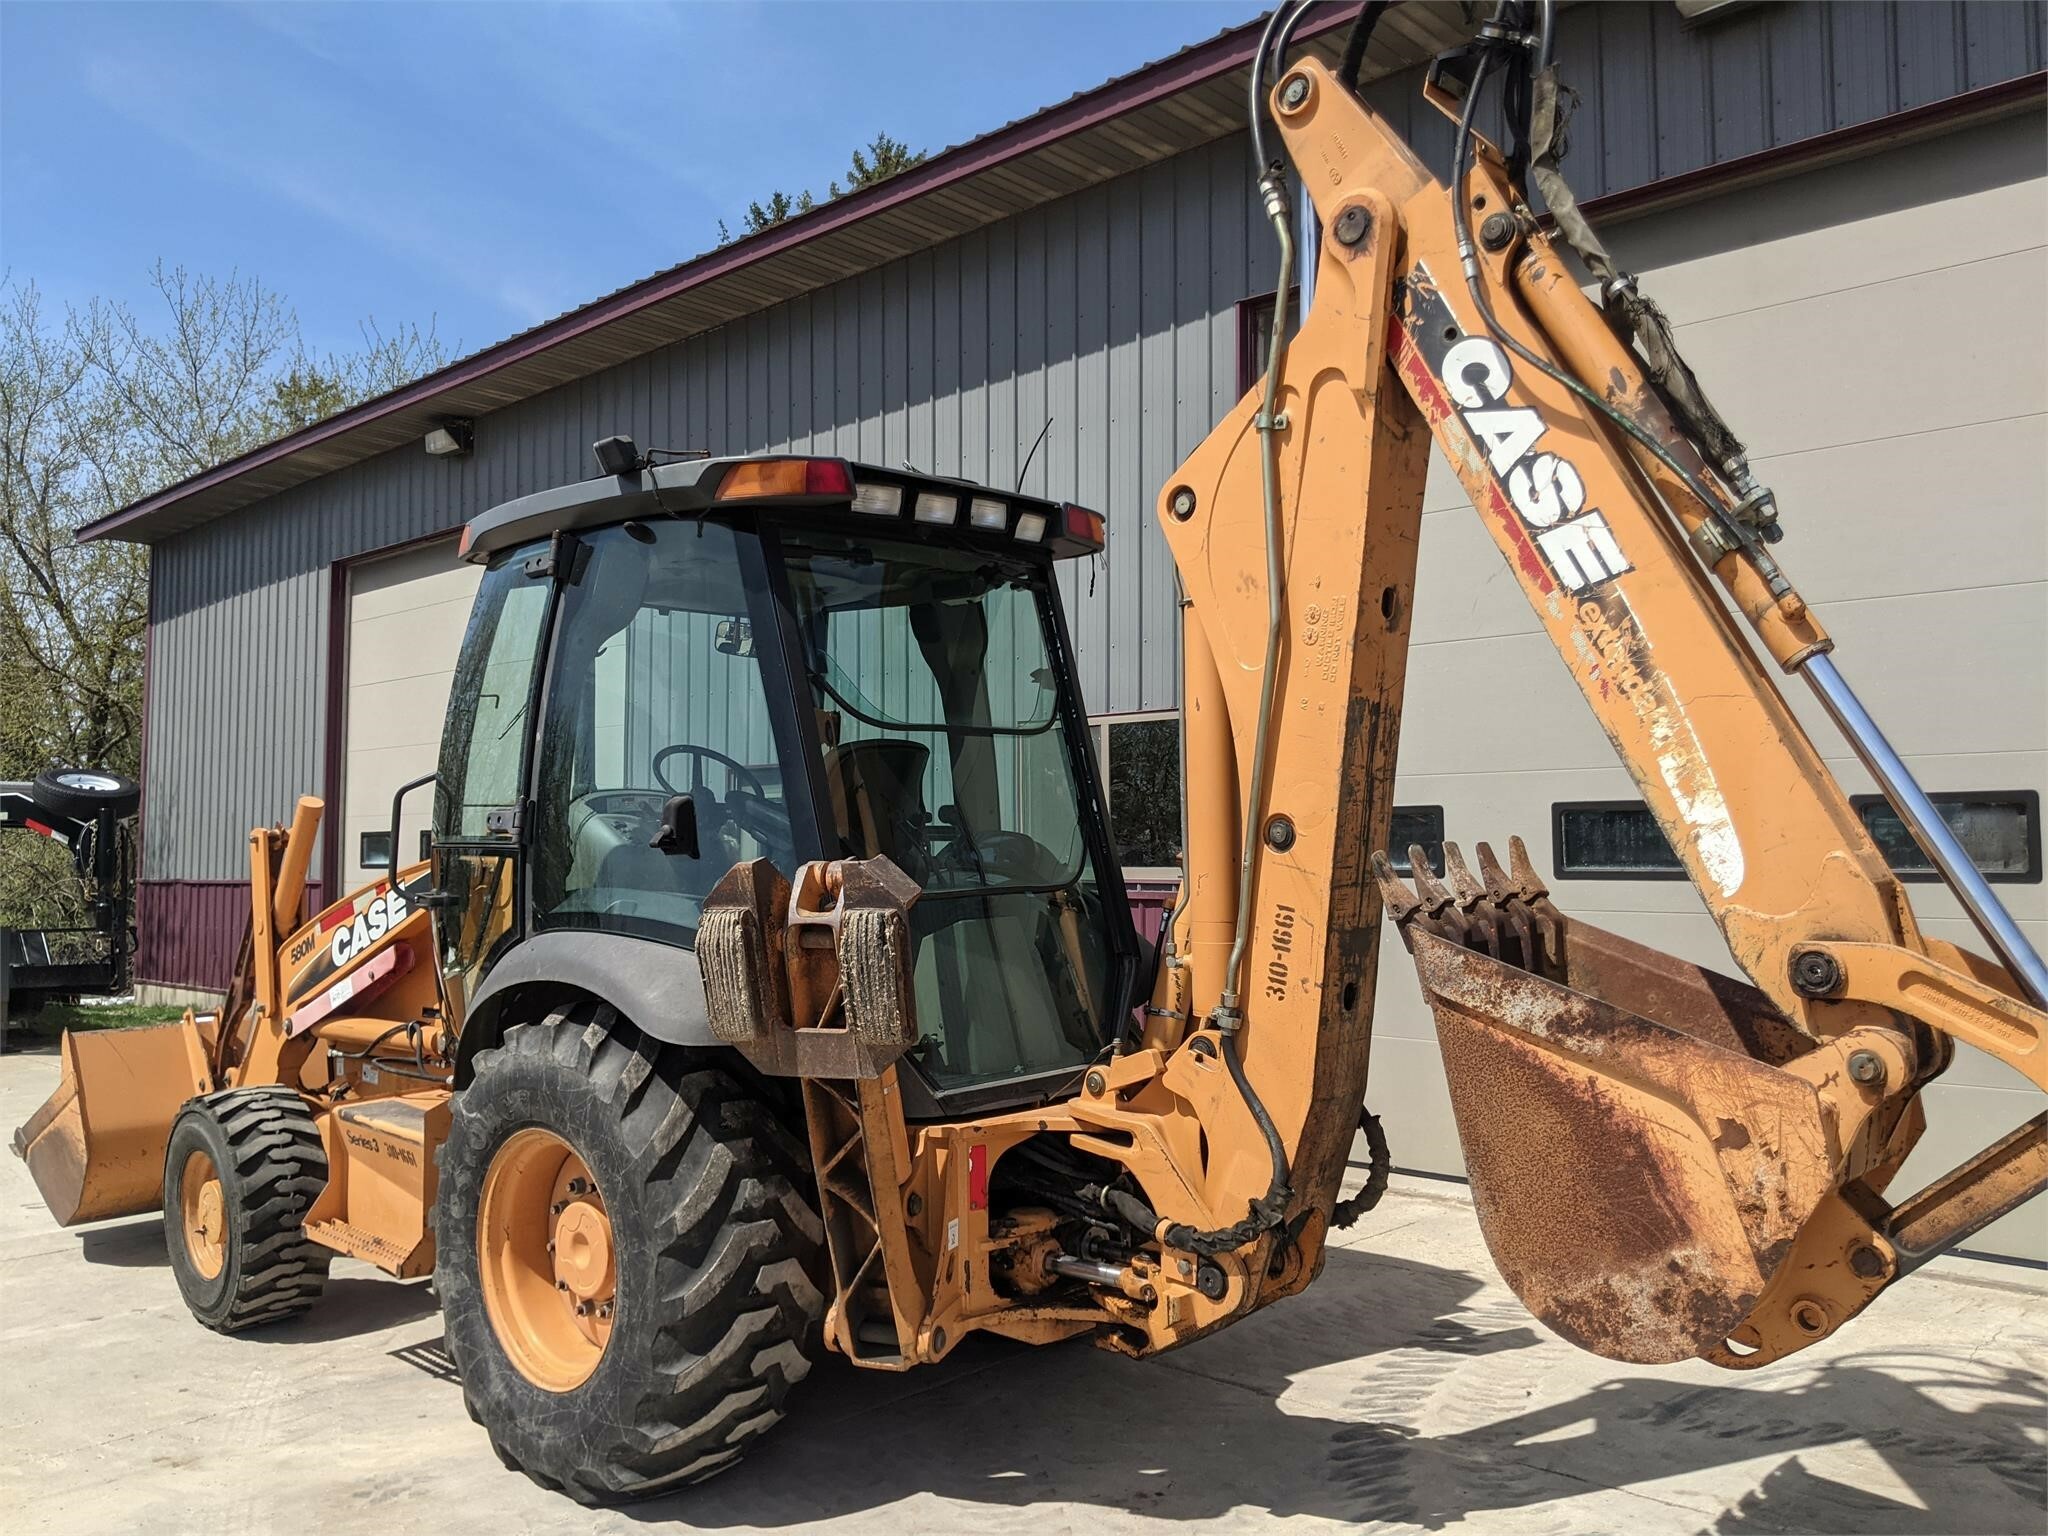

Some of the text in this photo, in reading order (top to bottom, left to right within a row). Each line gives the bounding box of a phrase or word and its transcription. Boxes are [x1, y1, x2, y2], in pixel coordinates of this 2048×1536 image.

[1441, 337, 1631, 590] CASE
[290, 933, 315, 965] 580M
[332, 881, 407, 967] CASE
[1266, 904, 1296, 1002] 310-1661
